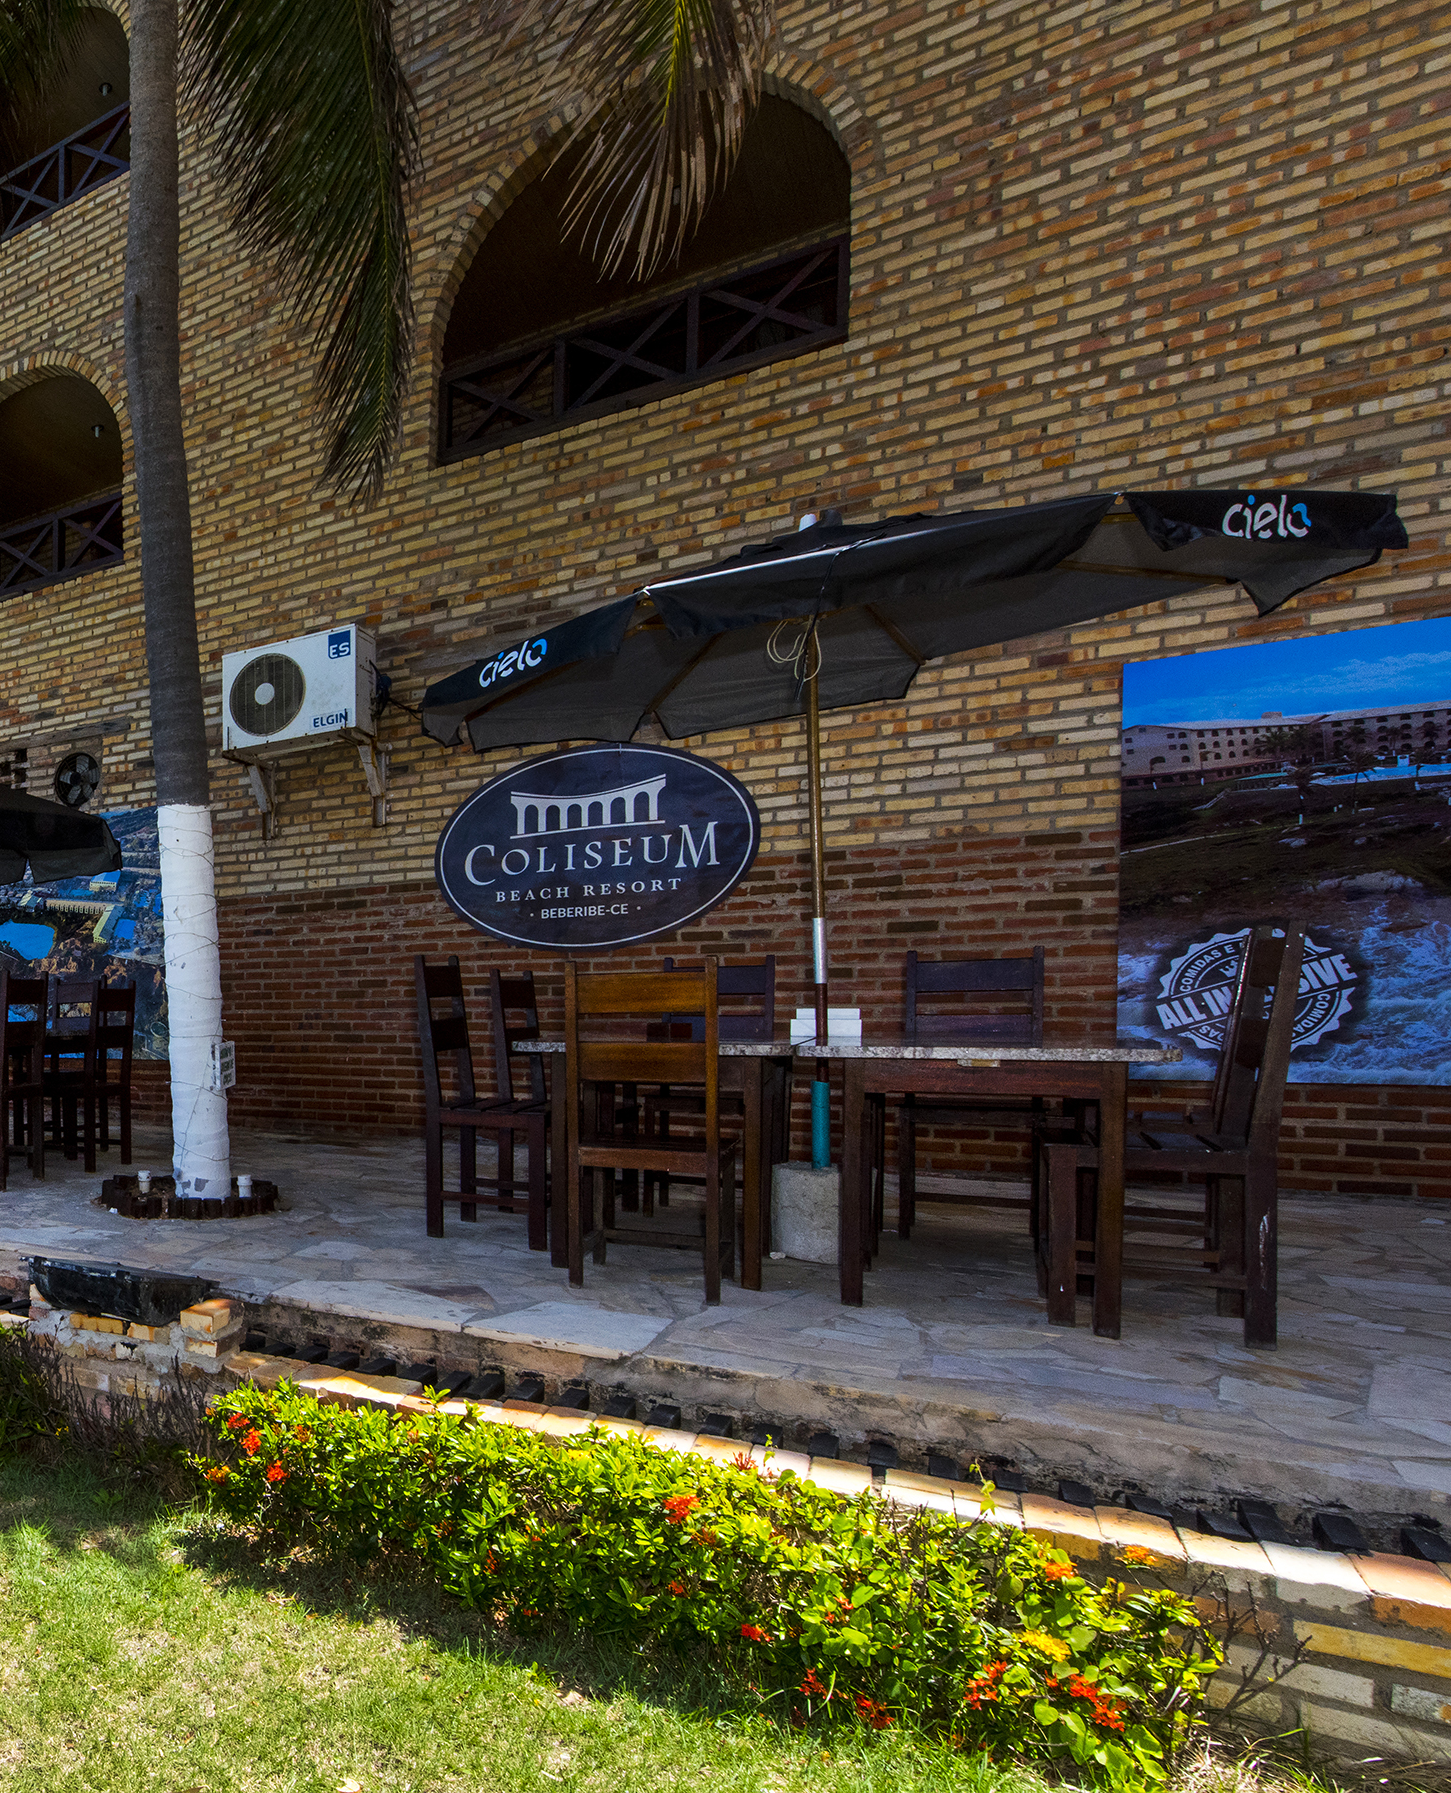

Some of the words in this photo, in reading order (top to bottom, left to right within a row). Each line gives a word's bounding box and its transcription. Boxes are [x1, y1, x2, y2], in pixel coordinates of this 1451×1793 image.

[1222, 494, 1312, 539] cielo
[329, 642, 350, 659] ES
[479, 638, 548, 688] cielo
[313, 710, 348, 728] ELGIN
[464, 820, 721, 887] COLISEUM
[495, 886, 570, 903] BEACH
[583, 877, 682, 897] RESORT
[540, 904, 629, 919] BEBERIBE-CE
[1179, 949, 1223, 993] COMIDAS
[1223, 944, 1236, 955] E
[1155, 996, 1208, 1030] ALL
[1201, 953, 1358, 1017] INIVE
[1291, 993, 1332, 1038] COMIDA
